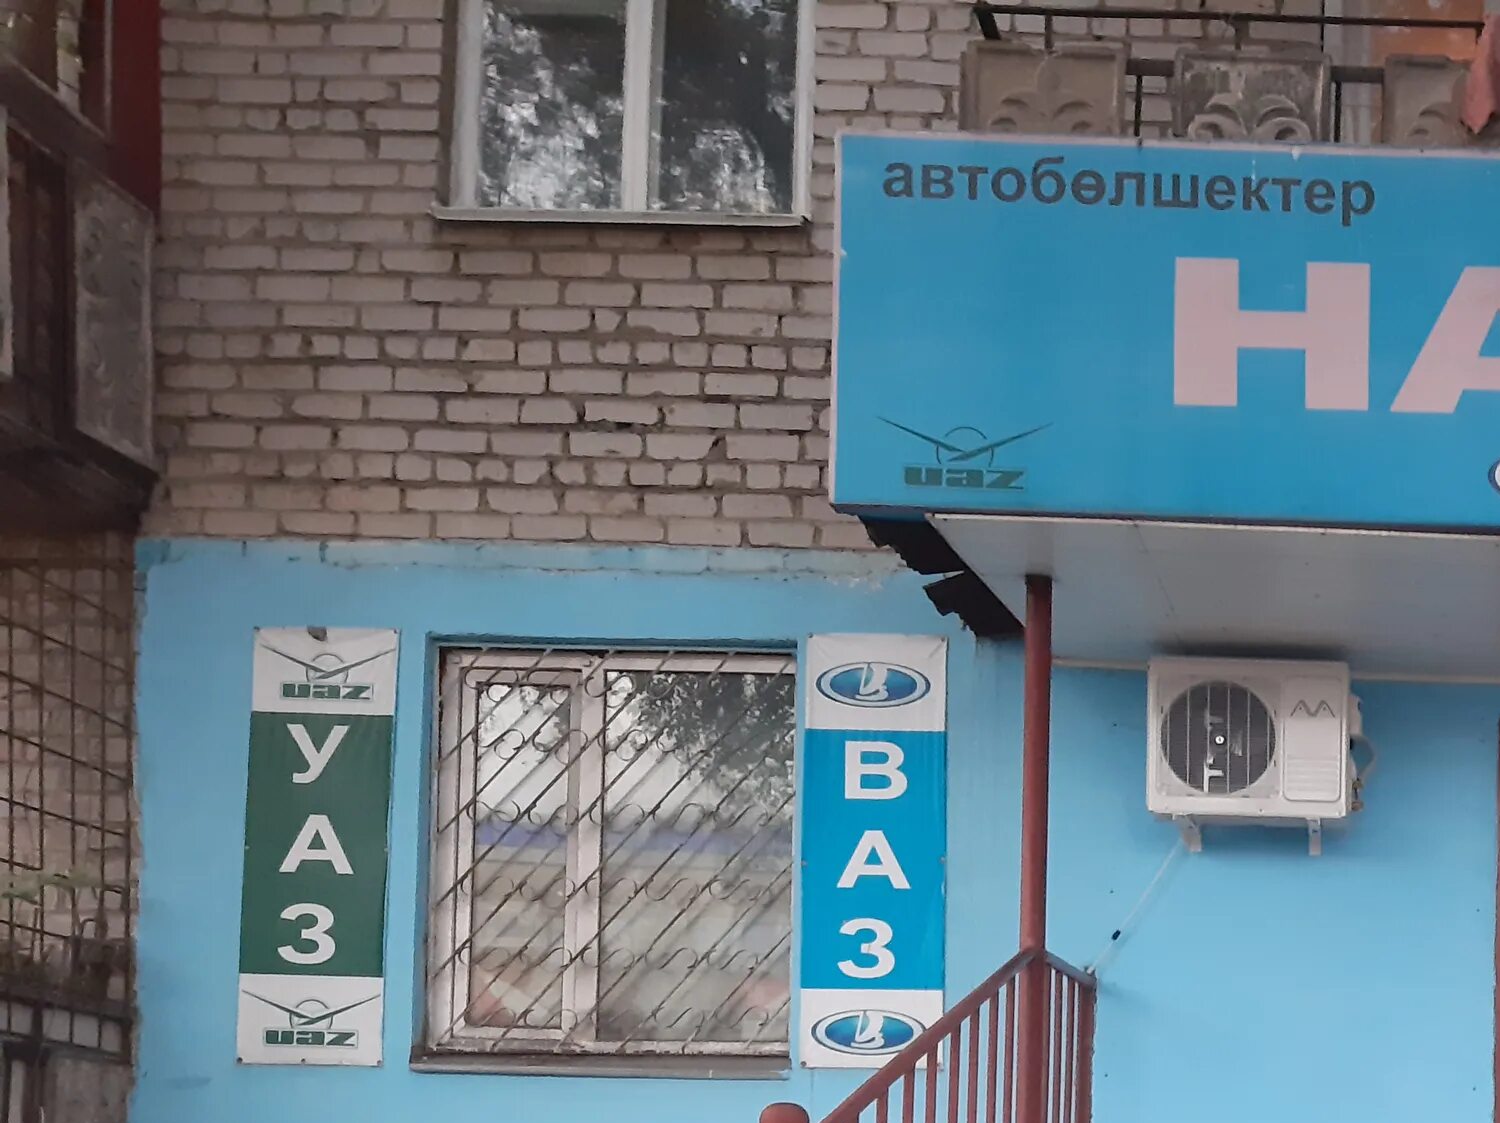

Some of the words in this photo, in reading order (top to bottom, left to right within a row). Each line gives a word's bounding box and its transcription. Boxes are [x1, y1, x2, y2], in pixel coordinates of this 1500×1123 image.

[882, 156, 1376, 227] автобөлшектер
[277, 724, 354, 965] УАЗ
[836, 740, 911, 980] ВАЗ
